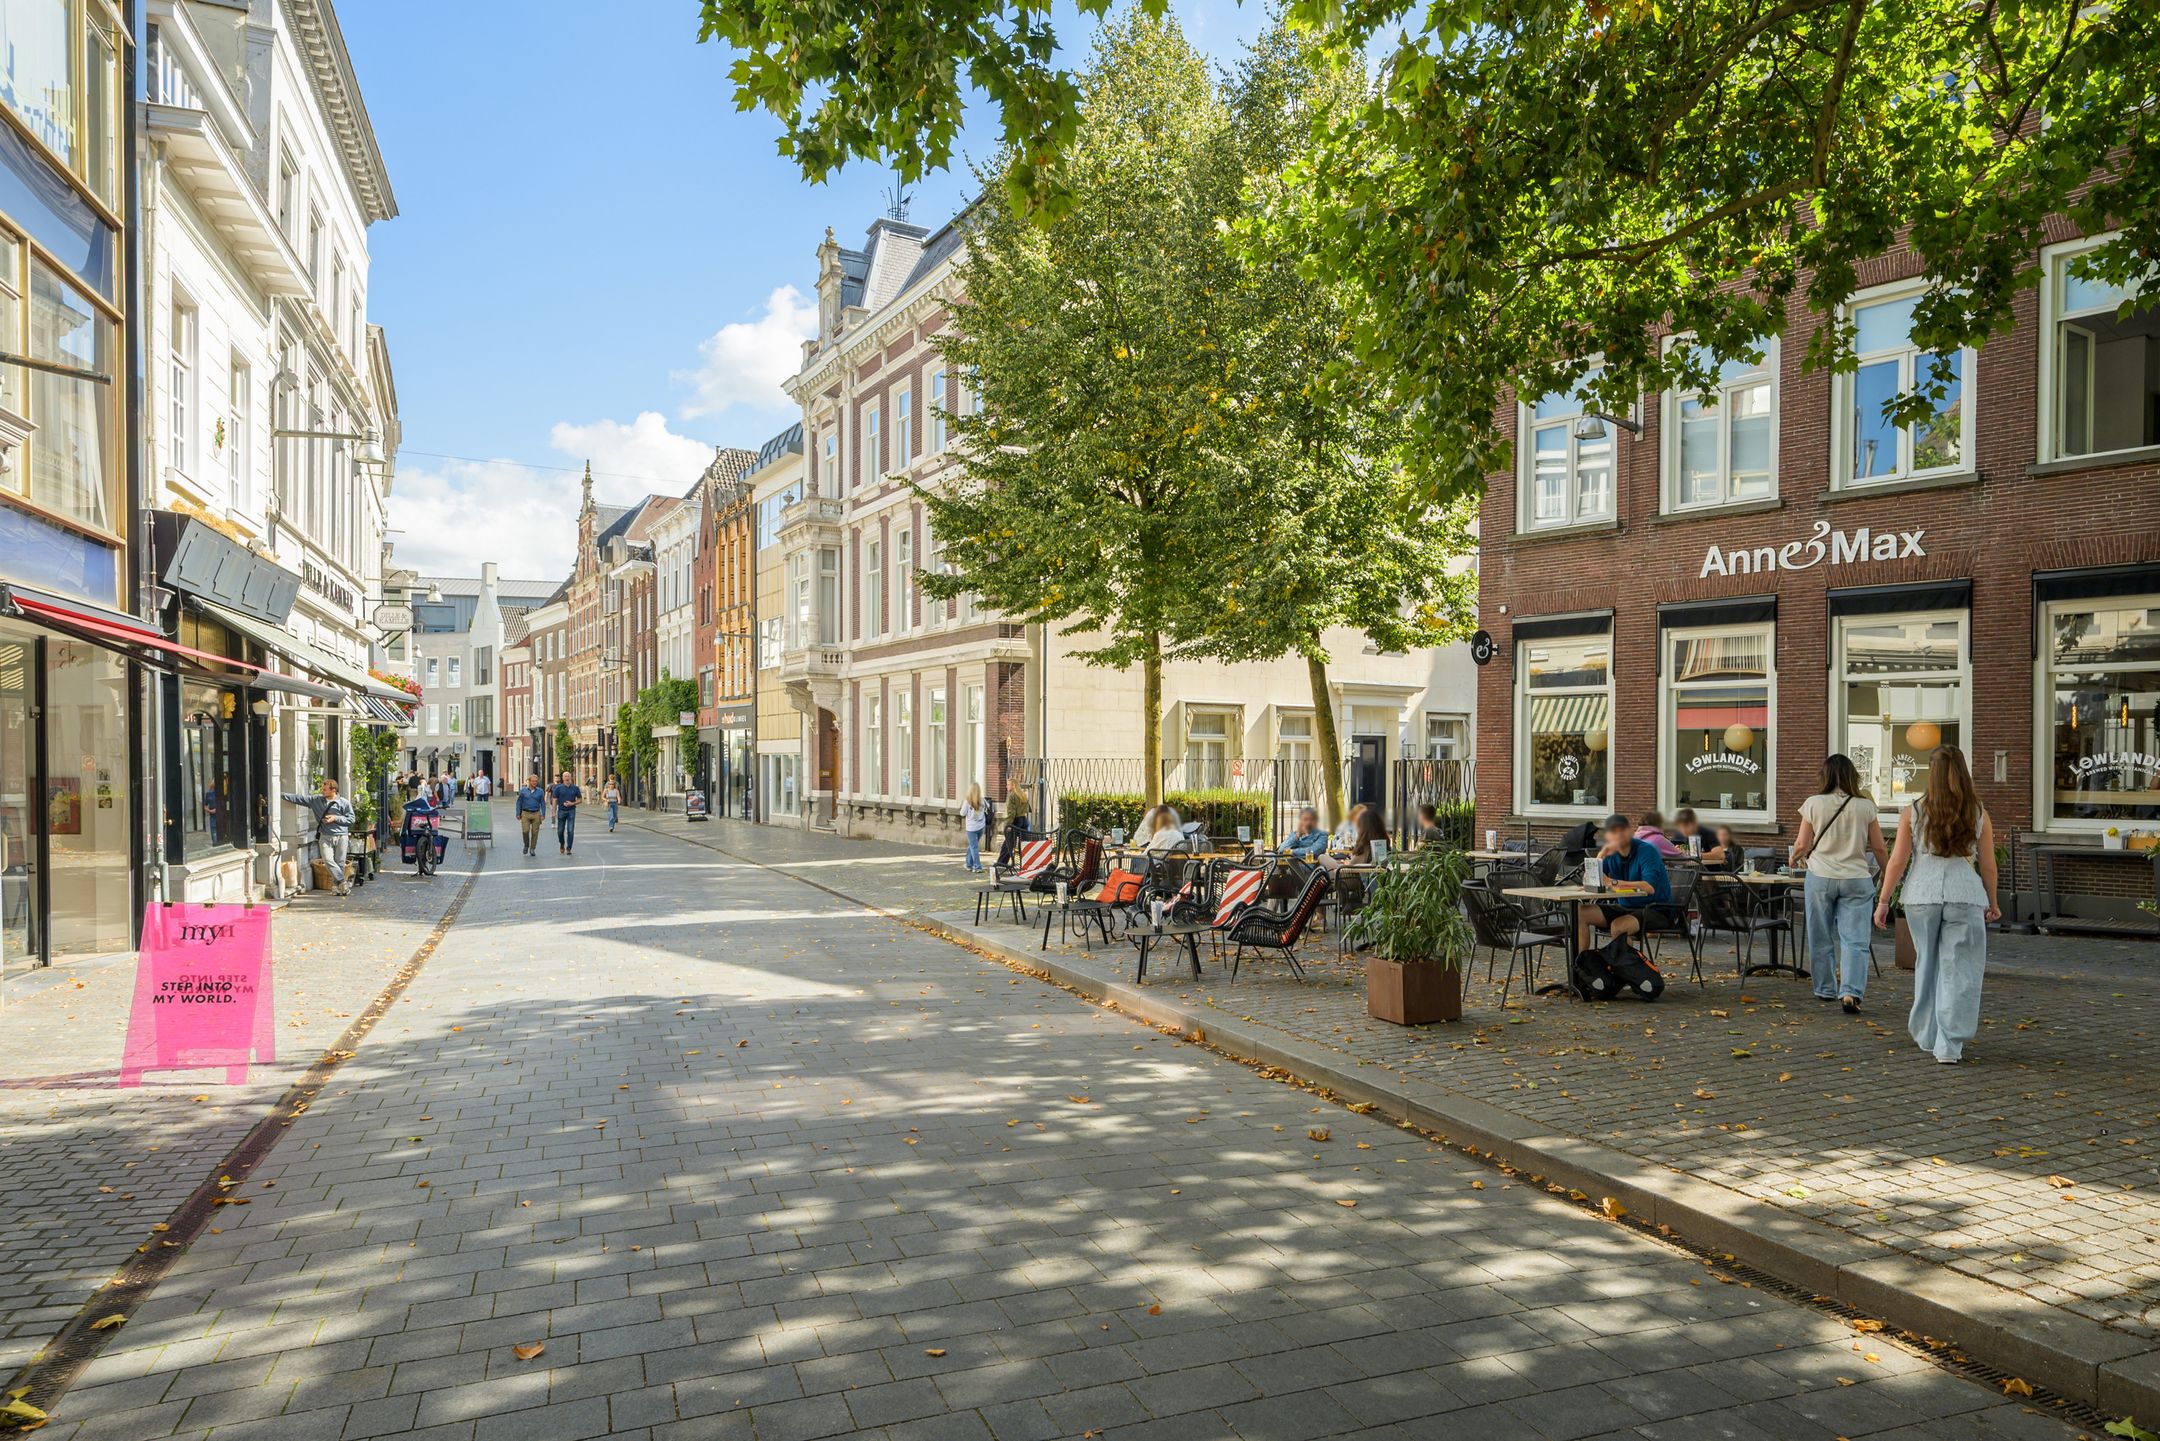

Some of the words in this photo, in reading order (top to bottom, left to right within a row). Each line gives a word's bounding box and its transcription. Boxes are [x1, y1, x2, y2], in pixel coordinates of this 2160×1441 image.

[2085, 767, 2107, 776] BREWED
[180, 924, 224, 946] my
[161, 982, 193, 991] STEP
[199, 982, 233, 991] INTO
[153, 994, 175, 1004] MY
[180, 994, 236, 1004] WORLD.
